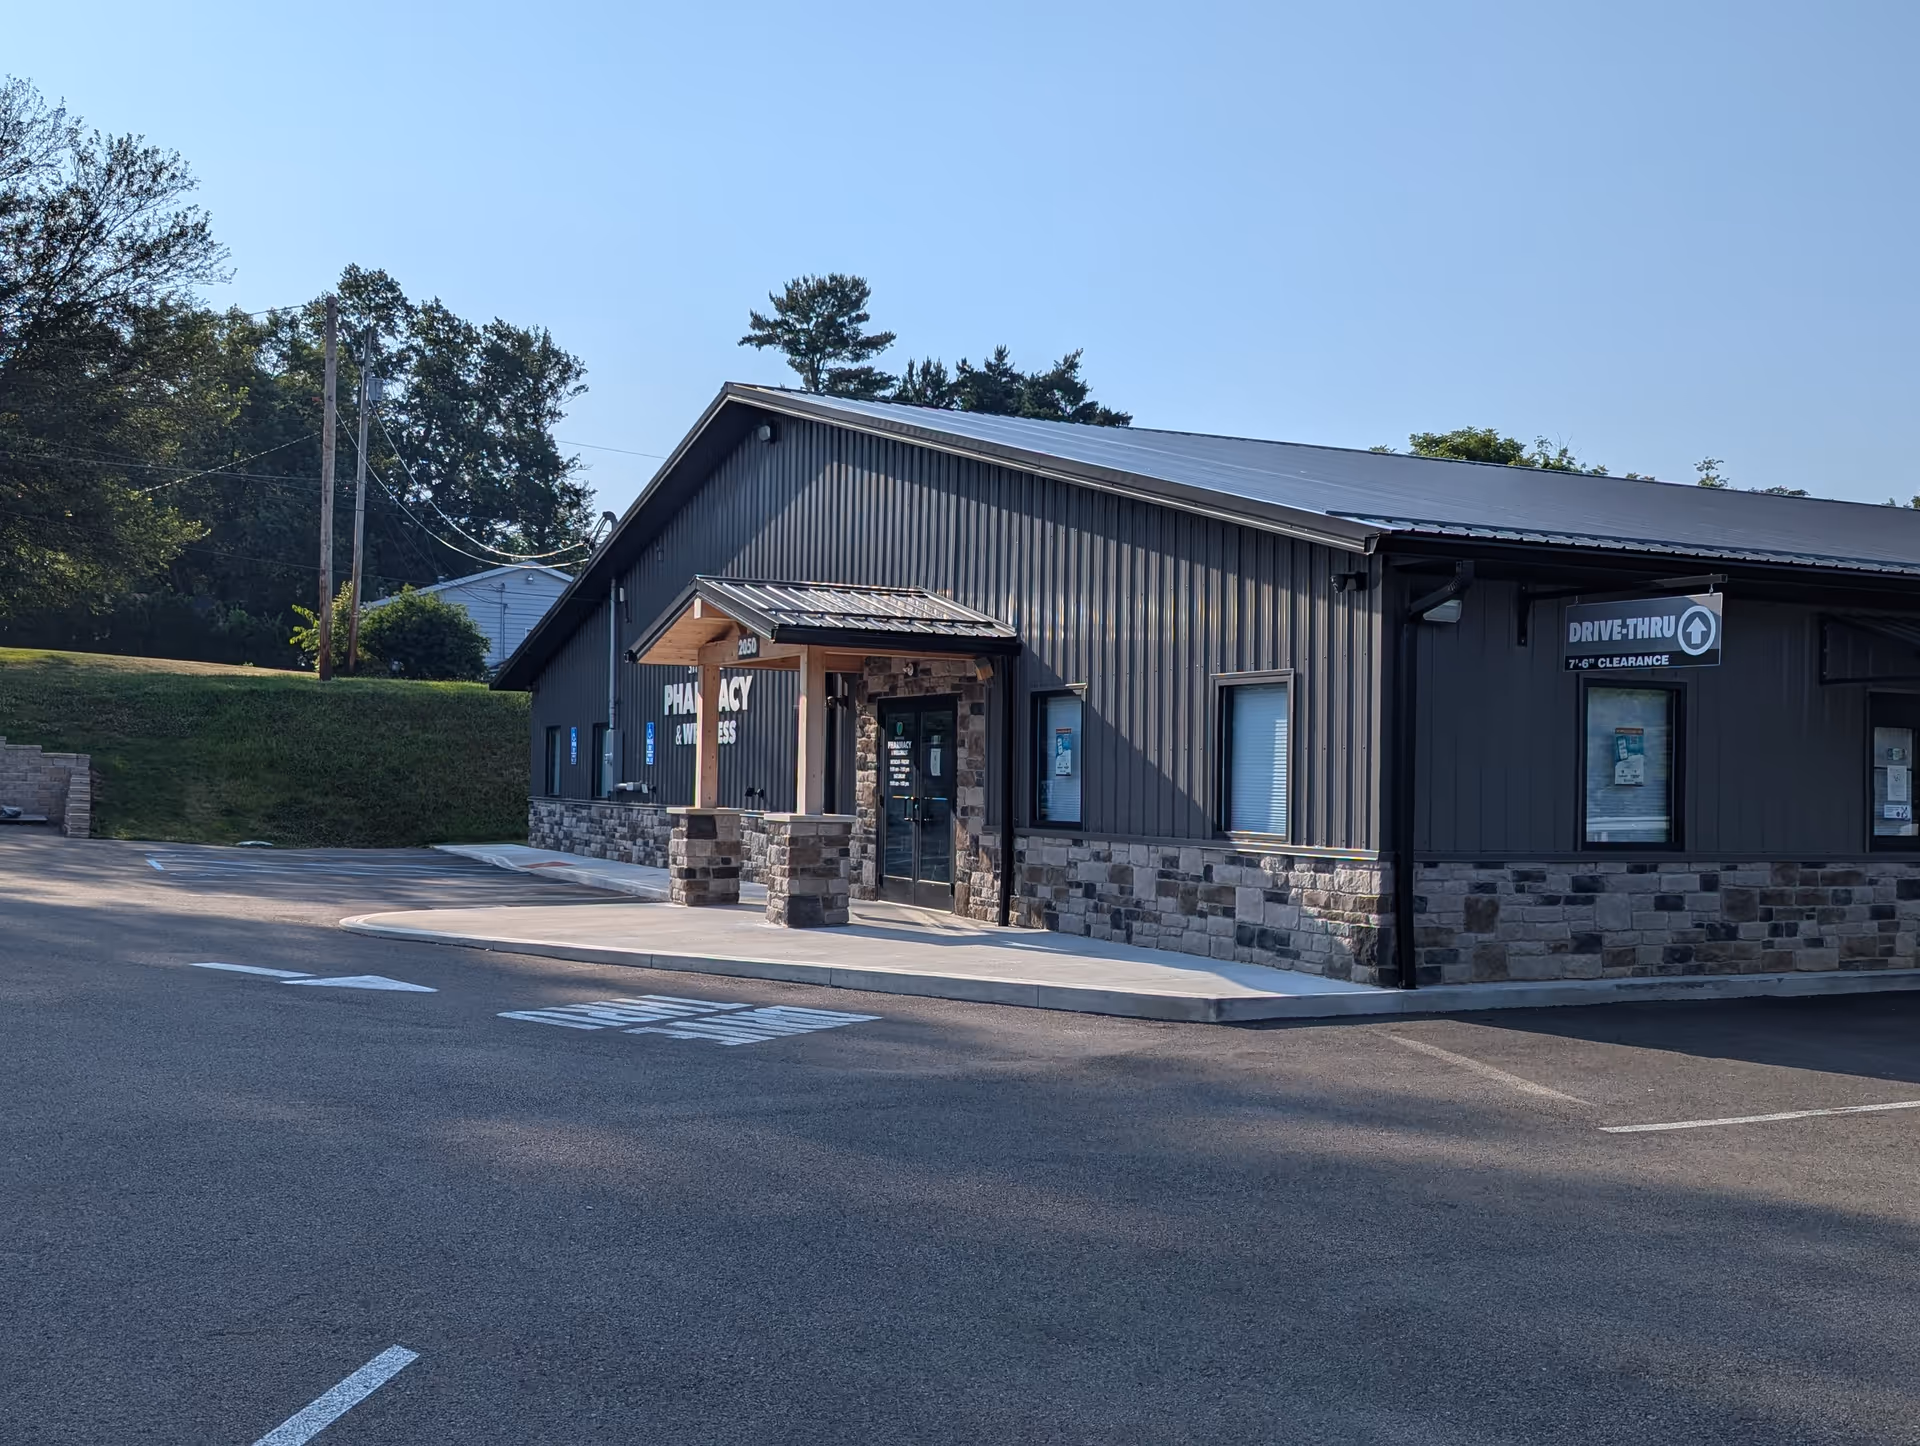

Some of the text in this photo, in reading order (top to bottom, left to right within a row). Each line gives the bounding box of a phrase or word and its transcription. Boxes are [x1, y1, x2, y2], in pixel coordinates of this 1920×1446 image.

[1569, 615, 1676, 643] DRIVE-THRU
[738, 637, 757, 656] 2050
[1597, 655, 1670, 668] CLEARANCE
[664, 675, 753, 716] PHAACY
[675, 720, 737, 745] & WEESS
[496, 994, 754, 1031] THRU
[619, 1004, 884, 1046] DRIVE
